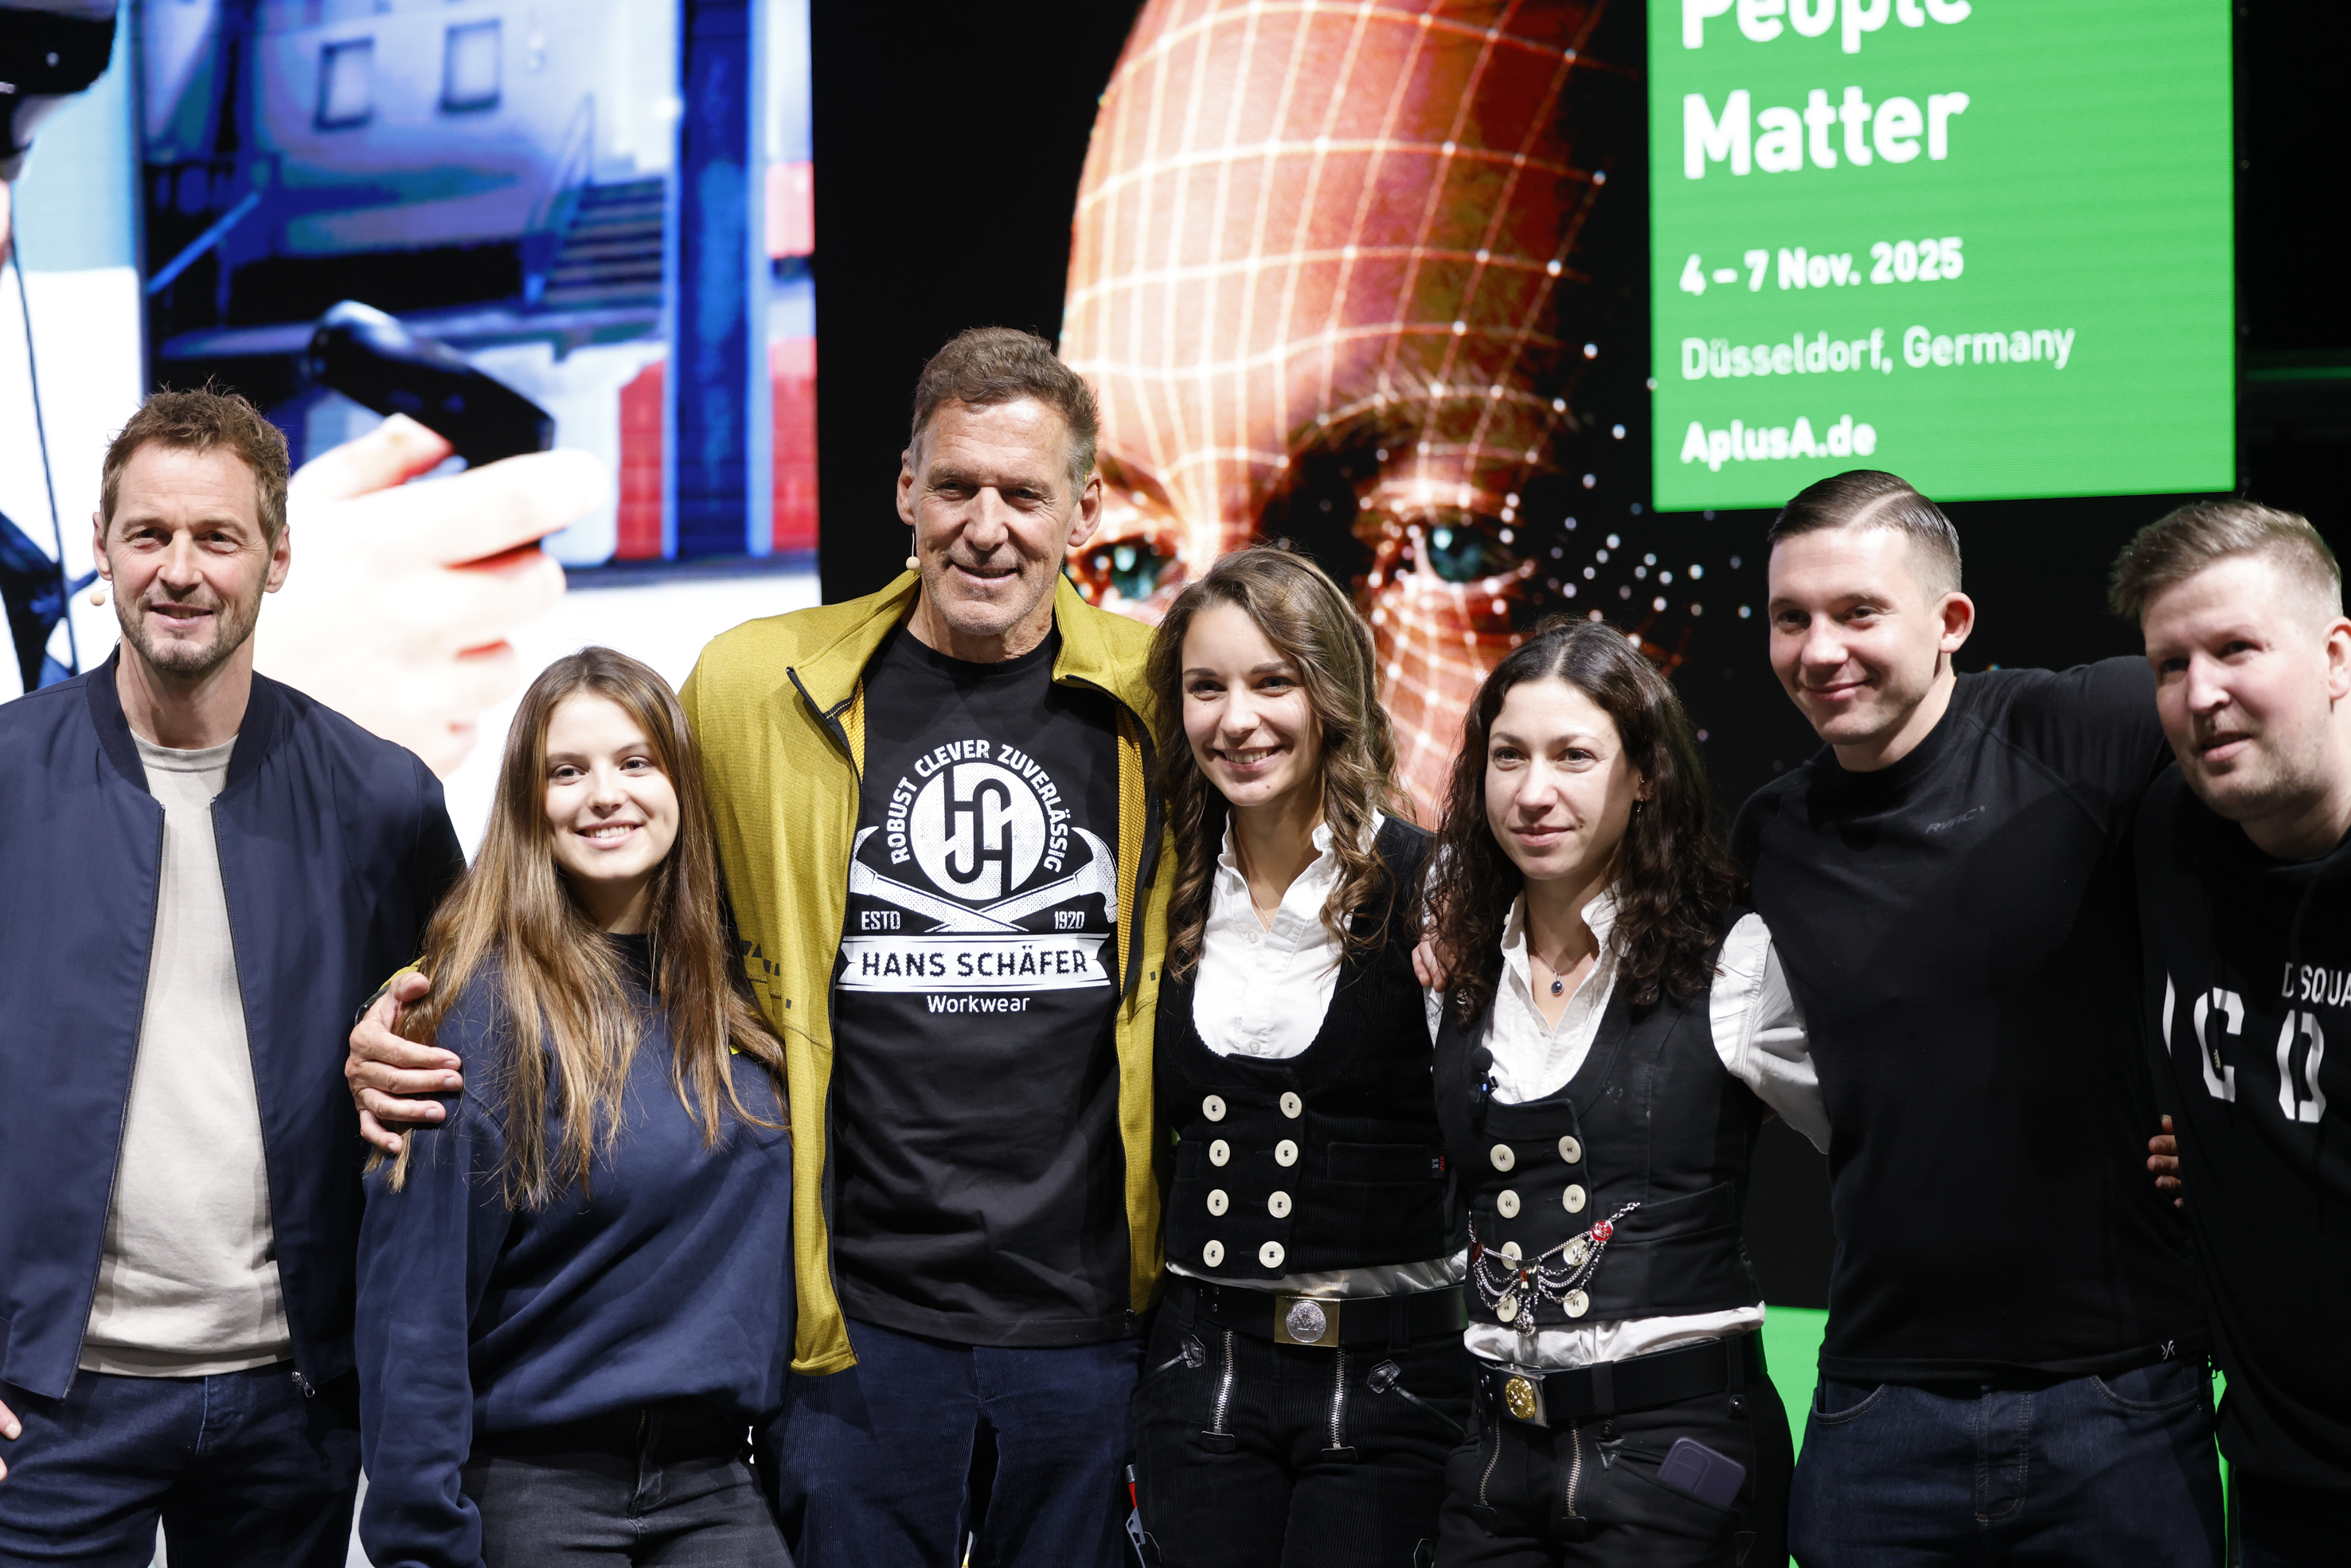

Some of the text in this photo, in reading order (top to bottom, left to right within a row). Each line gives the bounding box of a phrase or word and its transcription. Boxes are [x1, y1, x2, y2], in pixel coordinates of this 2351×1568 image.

[1683, 85, 1970, 180] Matter
[1778, 247, 1861, 291] Nov.
[1869, 236, 1964, 285] 2025
[1681, 325, 2076, 380] Düsseldorf, Germany
[1680, 414, 1877, 472] AplusA.de
[886, 739, 1072, 873] ROBUST CLEVER ZUVERLÄSSIG
[861, 911, 901, 930] ESTD
[1054, 911, 1085, 930] 1920
[861, 945, 1089, 977] HANS SCHÄFER
[926, 995, 1030, 1013] Workwear
